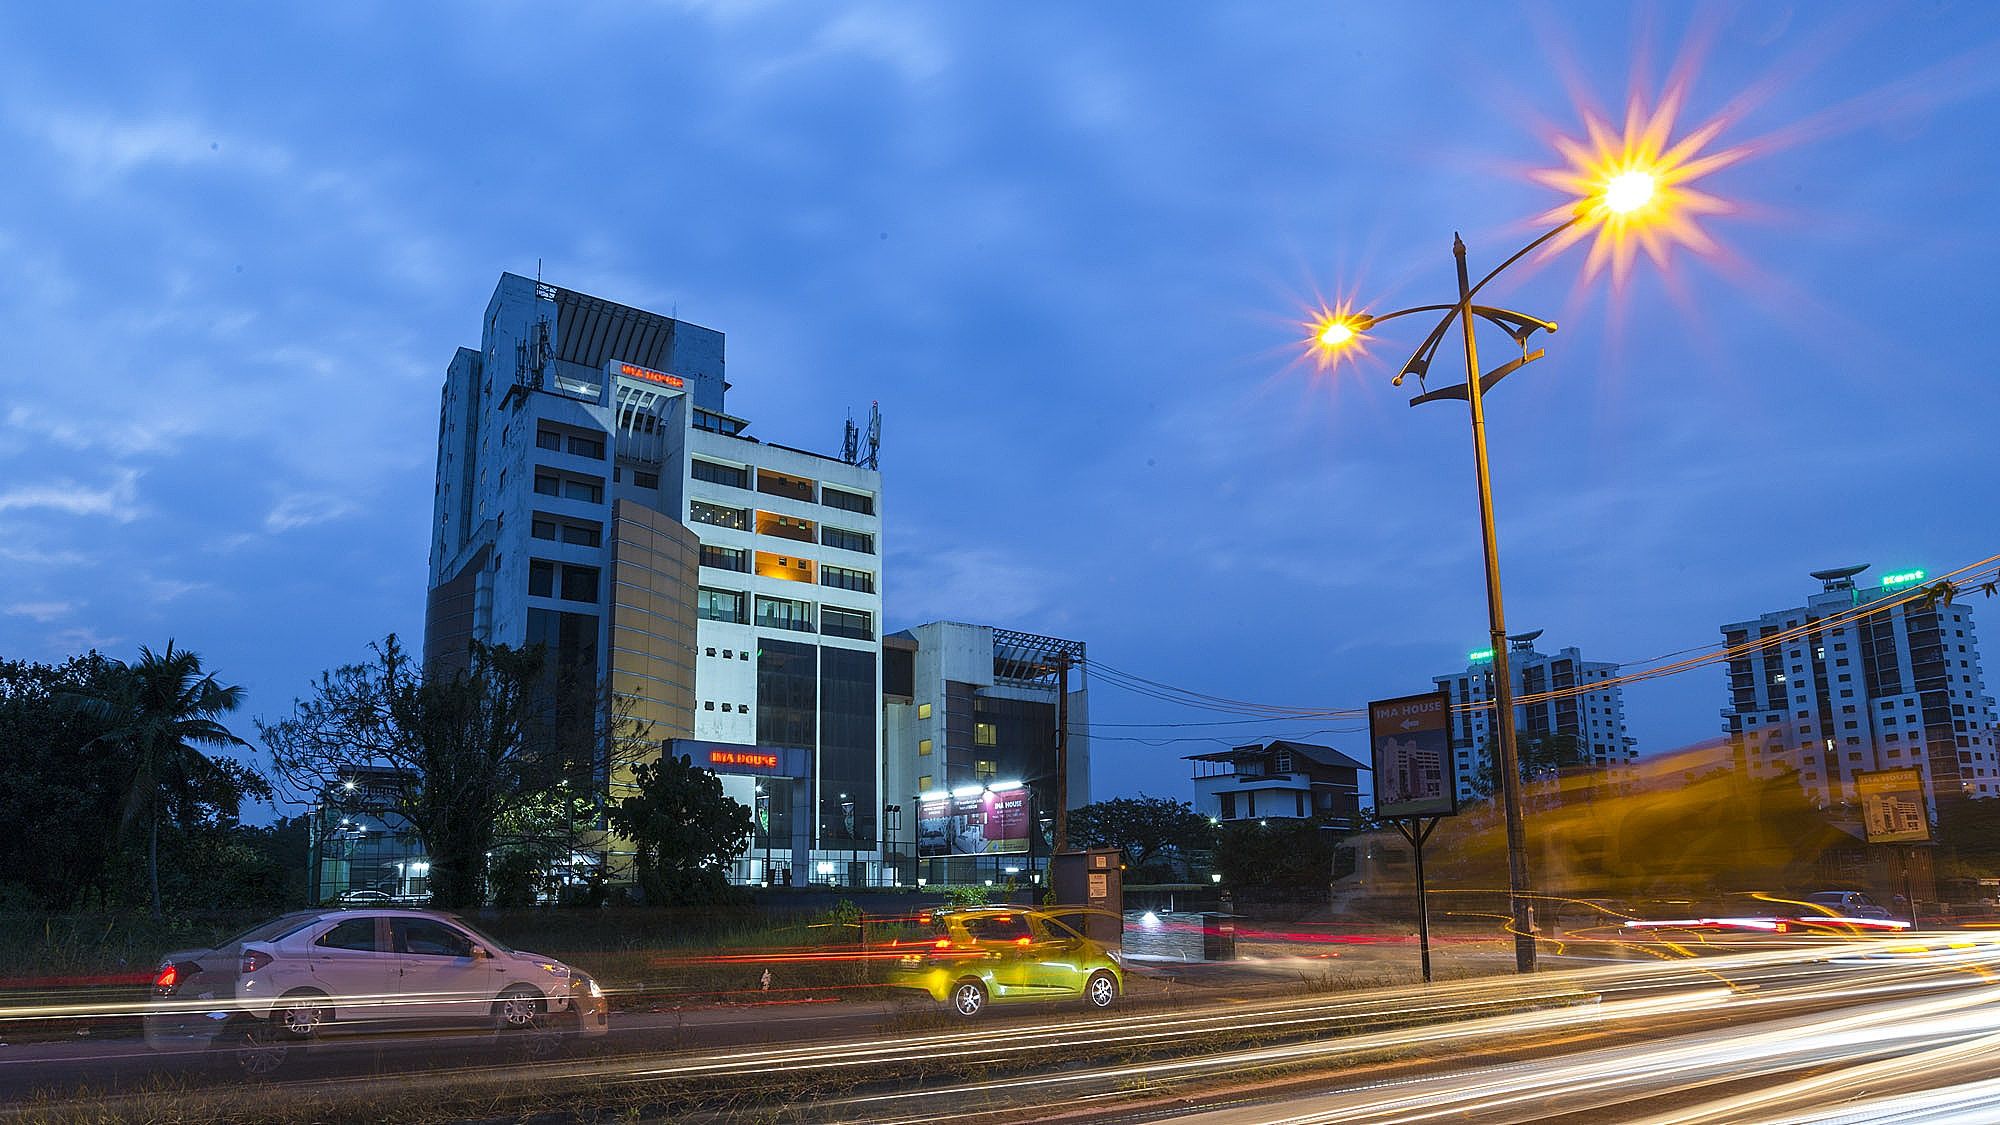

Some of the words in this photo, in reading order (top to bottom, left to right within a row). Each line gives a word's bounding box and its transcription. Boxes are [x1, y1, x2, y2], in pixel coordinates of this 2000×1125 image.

[622, 364, 643, 377] IMA
[1883, 570, 1924, 585] Kent
[1376, 707, 1399, 719] IMA
[1402, 702, 1441, 716] HOUSE
[711, 752, 734, 763] IMA
[737, 753, 777, 767] HOUSE
[1005, 801, 1022, 809] HOUSE
